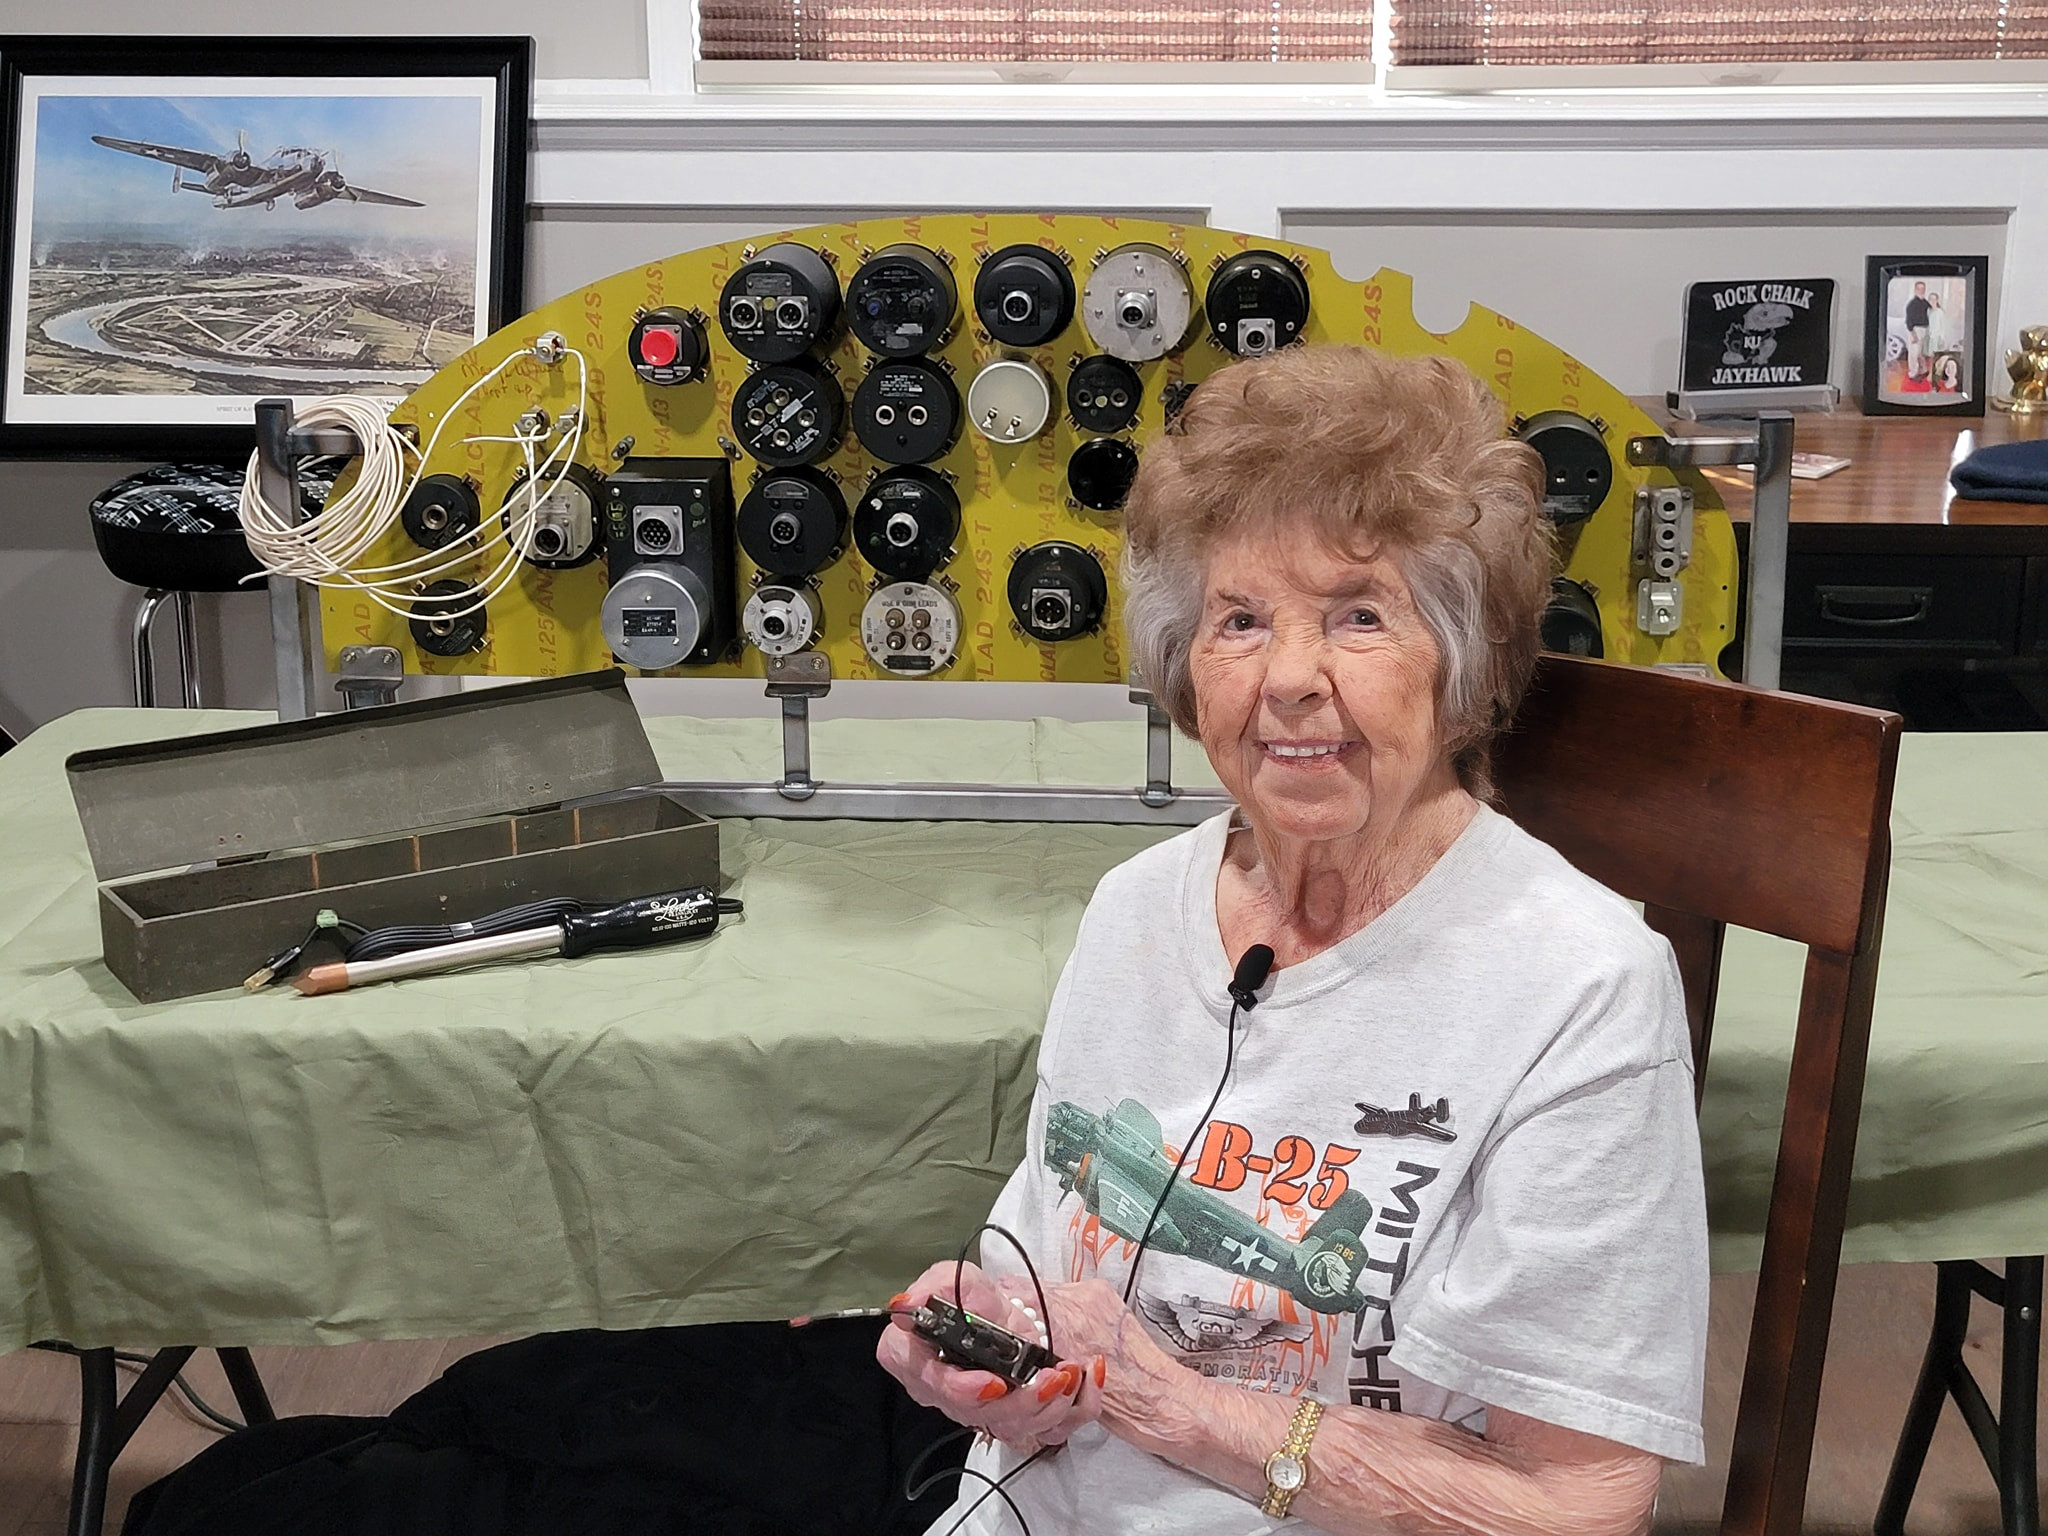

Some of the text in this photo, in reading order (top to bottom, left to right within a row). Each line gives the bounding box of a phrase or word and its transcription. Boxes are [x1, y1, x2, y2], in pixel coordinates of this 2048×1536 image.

[1712, 284, 1814, 311] ROCK CHALK
[1743, 335, 1762, 350] KU
[1711, 365, 1802, 385] JAYHAWK
[974, 520, 993, 605] 24S-T
[1189, 1119, 1362, 1210] B-25
[1333, 1242, 1356, 1261] 1385
